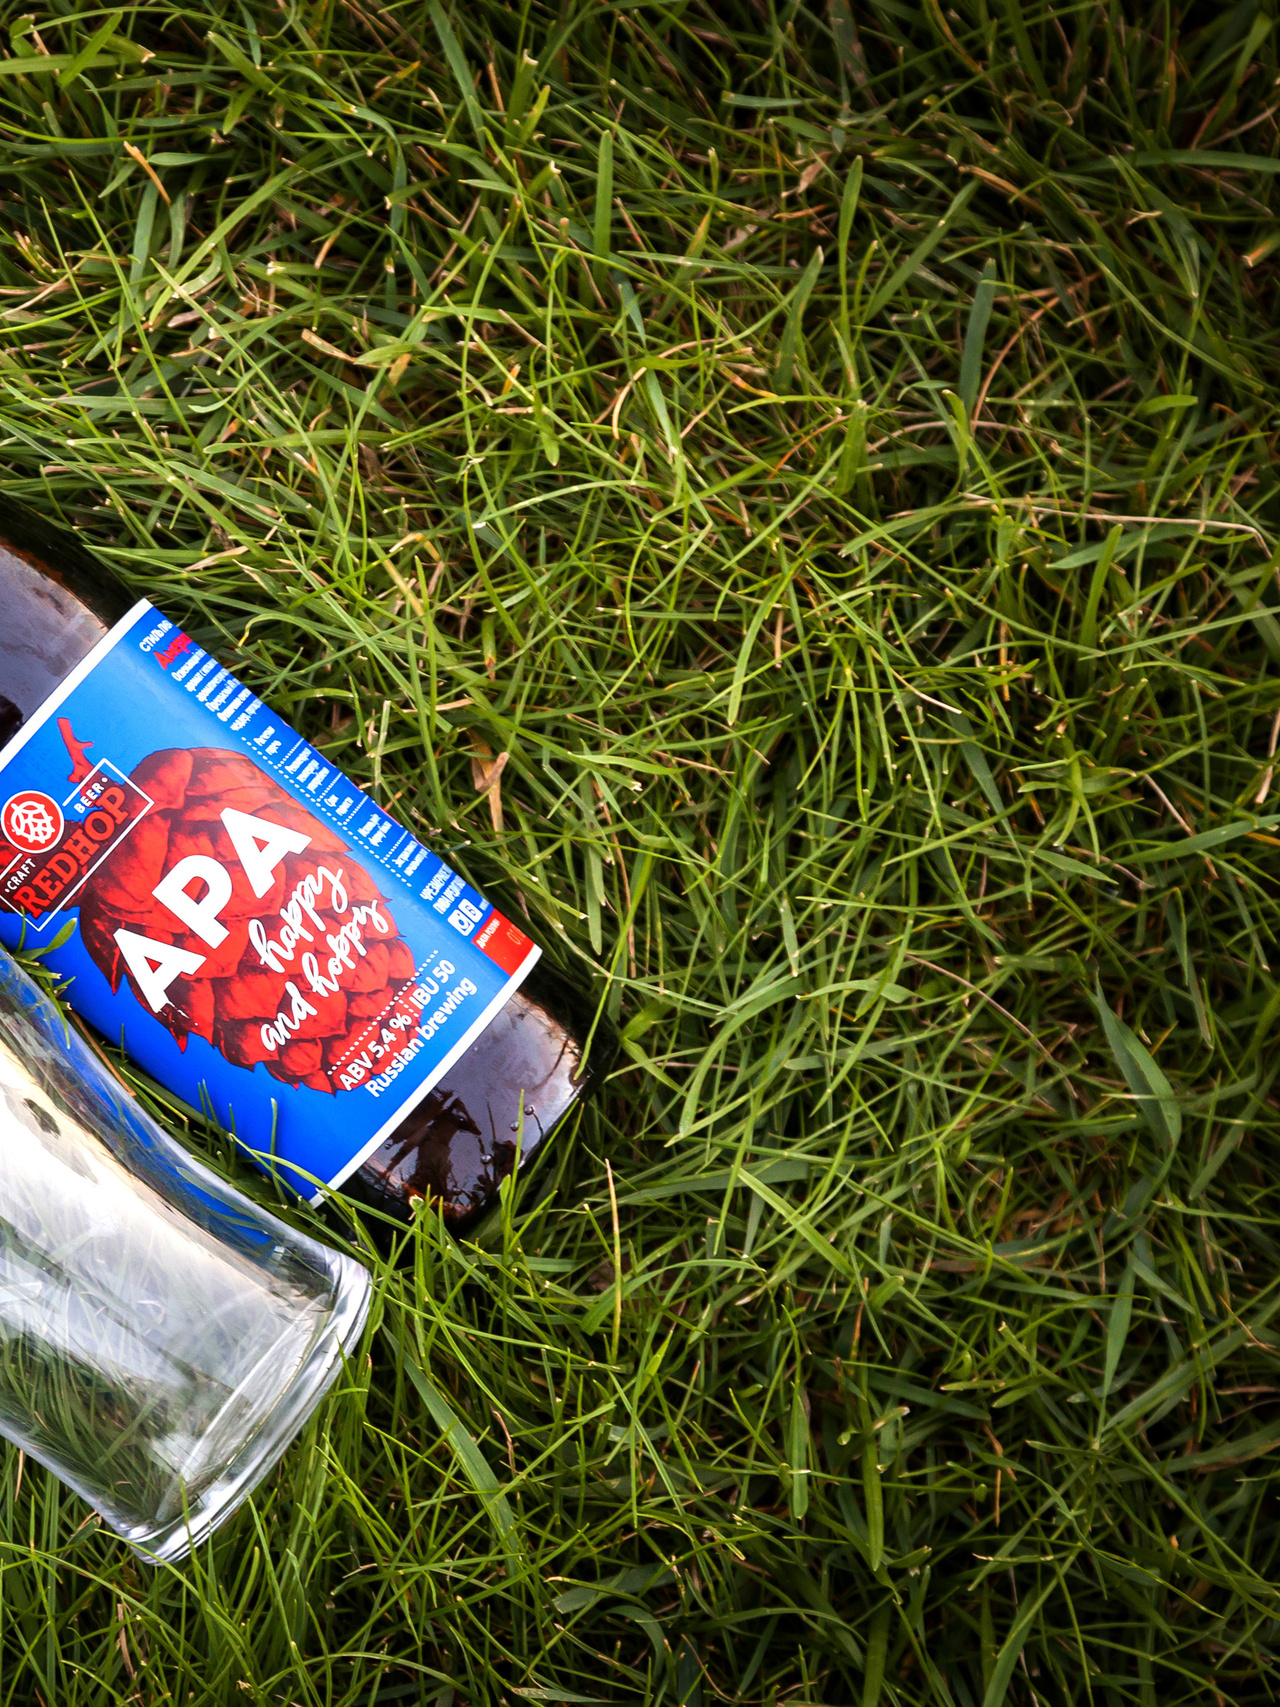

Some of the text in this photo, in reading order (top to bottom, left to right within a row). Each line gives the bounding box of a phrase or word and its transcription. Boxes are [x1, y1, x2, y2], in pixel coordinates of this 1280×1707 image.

[139, 628, 165, 652] СТИЛЬ
[13, 786, 129, 919] REDHOP
[73, 782, 105, 814] BEER
[7, 857, 36, 891] CRAFT
[113, 807, 313, 1014] APA
[248, 866, 348, 973] happy
[260, 899, 389, 1051] and hoppy
[339, 960, 456, 1091] ABV 5,4 % IBU 50
[365, 977, 478, 1098] Russian brewing
